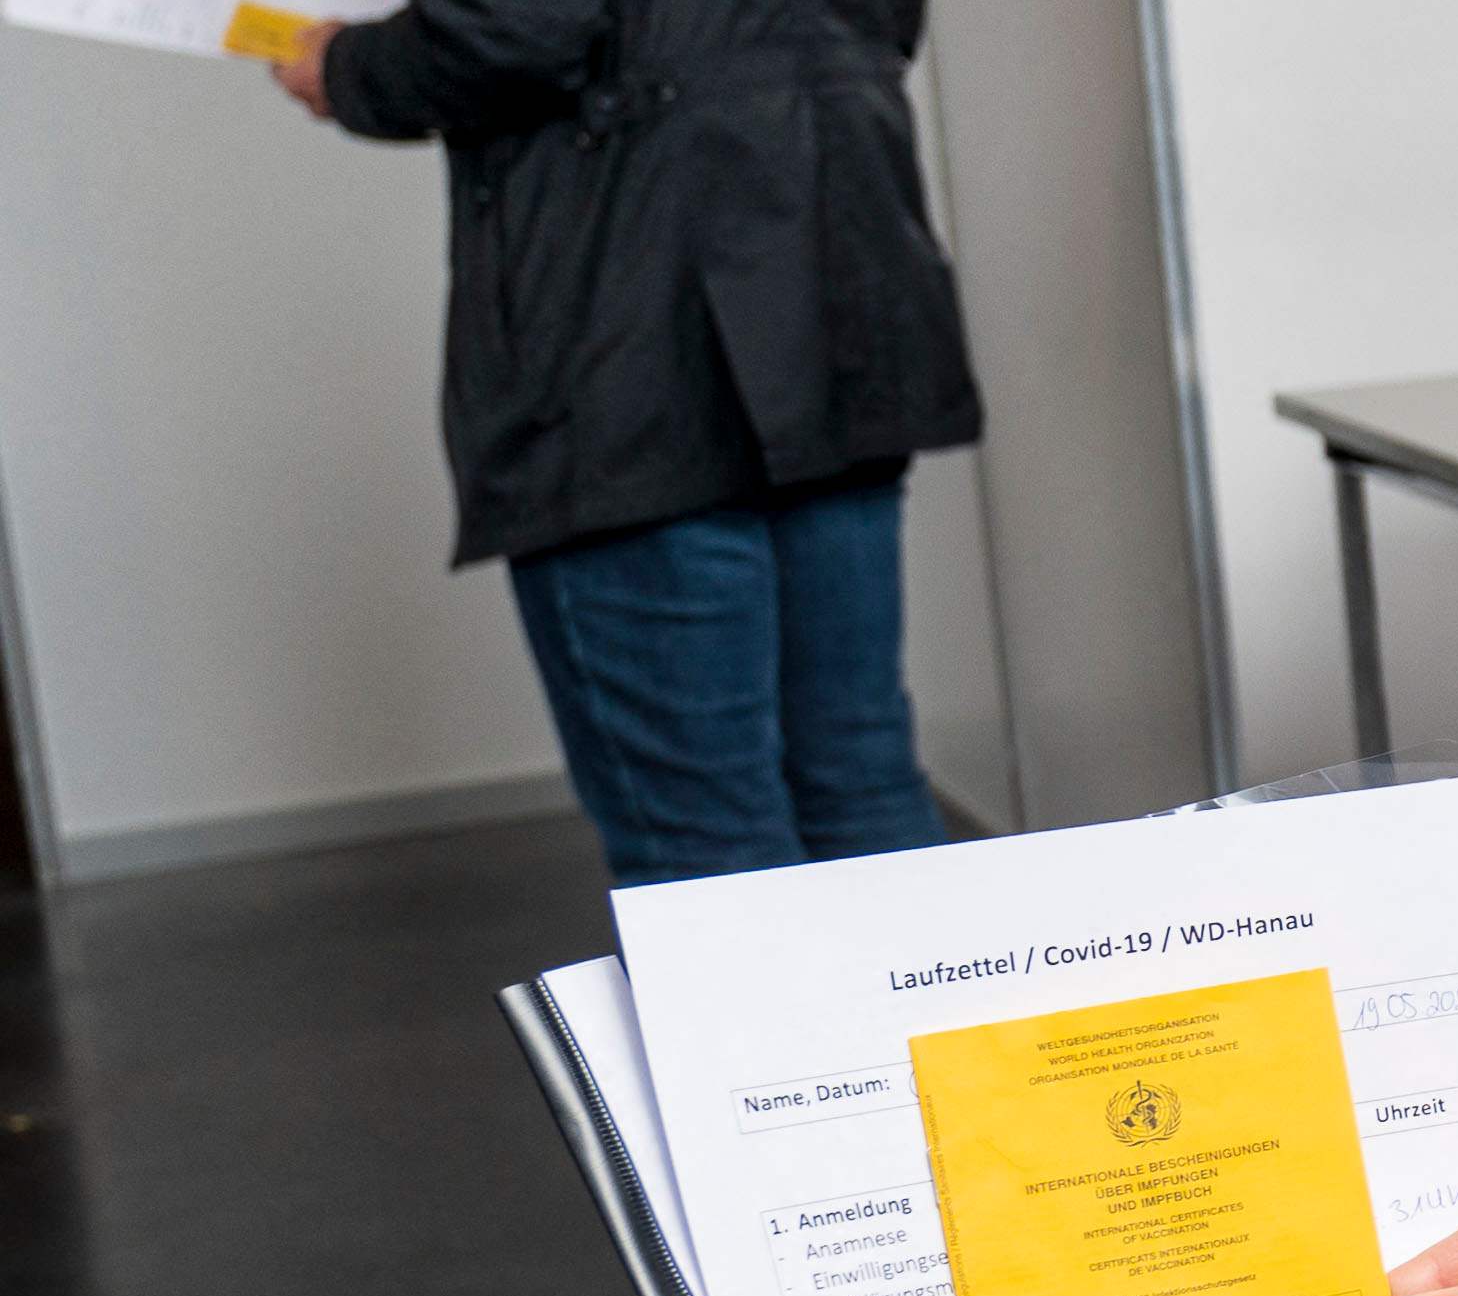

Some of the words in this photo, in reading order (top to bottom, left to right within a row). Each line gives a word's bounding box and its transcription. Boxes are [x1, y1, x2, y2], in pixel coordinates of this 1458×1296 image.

[889, 950, 1016, 992] Laufzettel
[1025, 946, 1035, 974] /
[1043, 931, 1154, 967] Covid-19
[1162, 925, 1172, 953] /
[1180, 910, 1315, 946] WD-Hanau
[1036, 1013, 1220, 1052] WELTGESUNDHEITSORGANISATION
[1048, 1051, 1089, 1067] WORLD
[1091, 1043, 1134, 1060] HEALTH
[1135, 1030, 1215, 1052] ORGANIZATION
[1029, 1064, 1110, 1086] ORGANISATION
[1112, 1054, 1168, 1072] MONDIALE
[1170, 1050, 1186, 1062] DE
[1188, 1047, 1202, 1059] LA
[744, 1091, 812, 1114] Name,
[816, 1076, 891, 1102] Datum:
[1375, 1097, 1447, 1124] Uhrzeit
[1024, 1164, 1145, 1196] INTERNATIONALE
[1148, 1138, 1281, 1174] BESCHEINIGUNGEN
[1137, 1167, 1220, 1192] IMPFUNGEN
[769, 1218, 789, 1236] 1.
[798, 1197, 914, 1231] Anmeldung
[1108, 1200, 1138, 1215] UND
[1141, 1185, 1213, 1208] IMPFBUCH
[1083, 1217, 1168, 1240] INTERNATIONAL
[1169, 1202, 1245, 1224] CERTIFICATES
[1122, 1233, 1138, 1245] OF
[1140, 1221, 1210, 1242] VACCINATION
[806, 1228, 908, 1261] Anamnese
[1088, 1252, 1158, 1272] CERTIFICATS
[1159, 1233, 1250, 1260] INTERNATIONAUX
[1128, 1265, 1144, 1277] DE
[1146, 1253, 1216, 1273] VACCINATION
